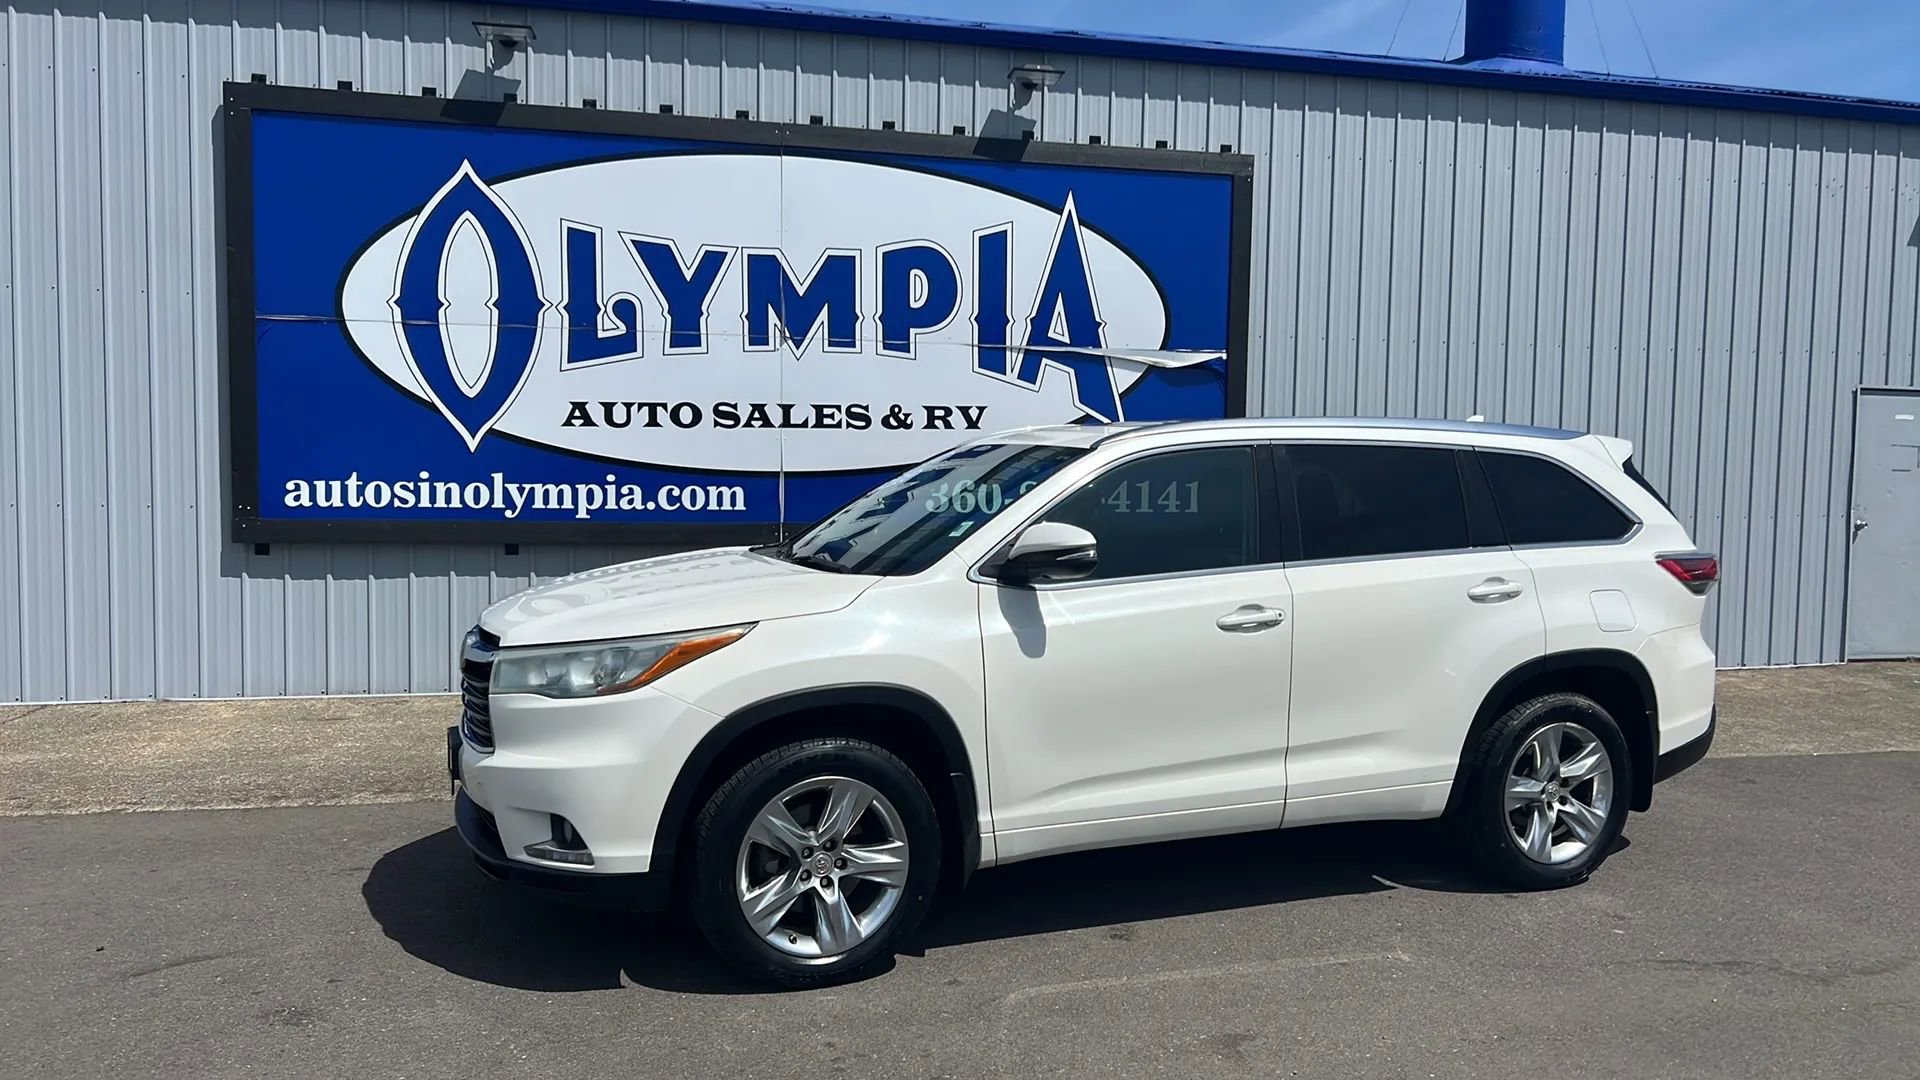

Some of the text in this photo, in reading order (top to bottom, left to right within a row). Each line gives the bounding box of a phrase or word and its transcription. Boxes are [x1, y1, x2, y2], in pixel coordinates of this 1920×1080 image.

[387, 158, 1125, 453] OLYMPIA
[560, 401, 988, 430] AUTO SALES & RV
[285, 471, 746, 518] autosinolympia.com
